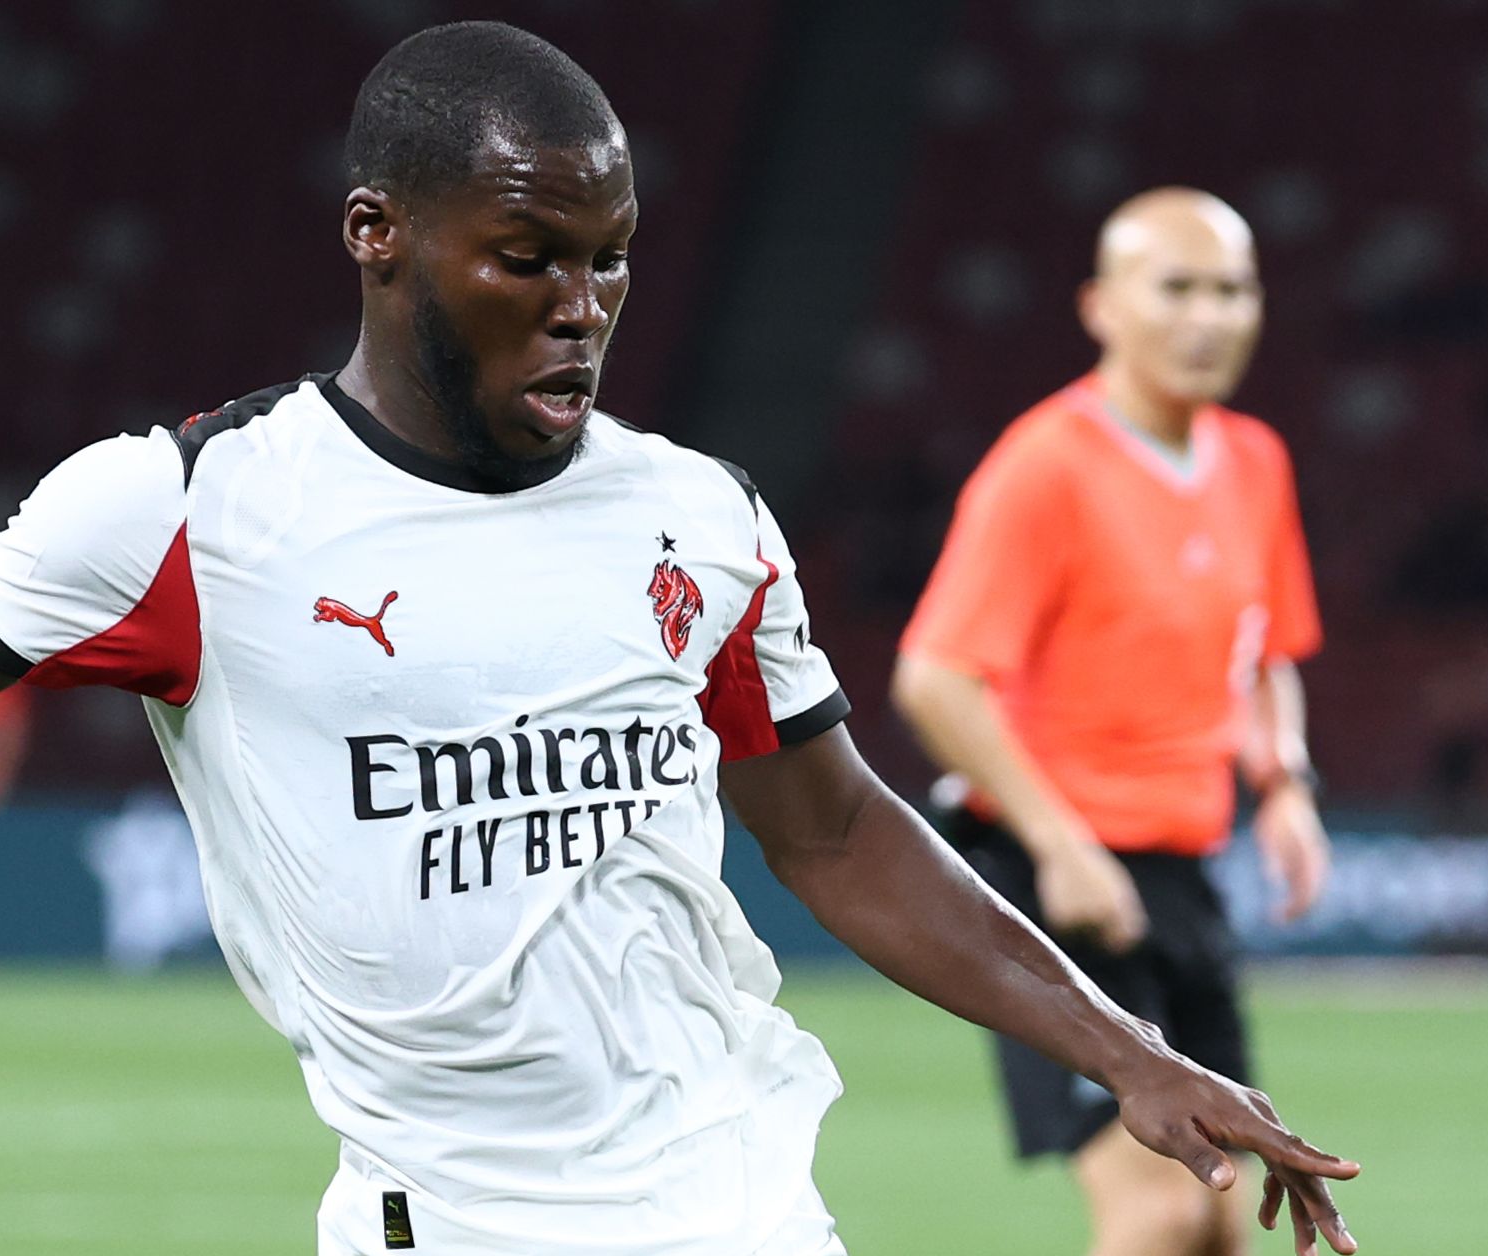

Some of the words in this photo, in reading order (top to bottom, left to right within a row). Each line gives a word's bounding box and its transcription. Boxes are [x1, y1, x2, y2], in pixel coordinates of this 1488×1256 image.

[344, 713, 698, 820] Emirates
[420, 817, 503, 901] FLY
[525, 800, 663, 877] BETT
